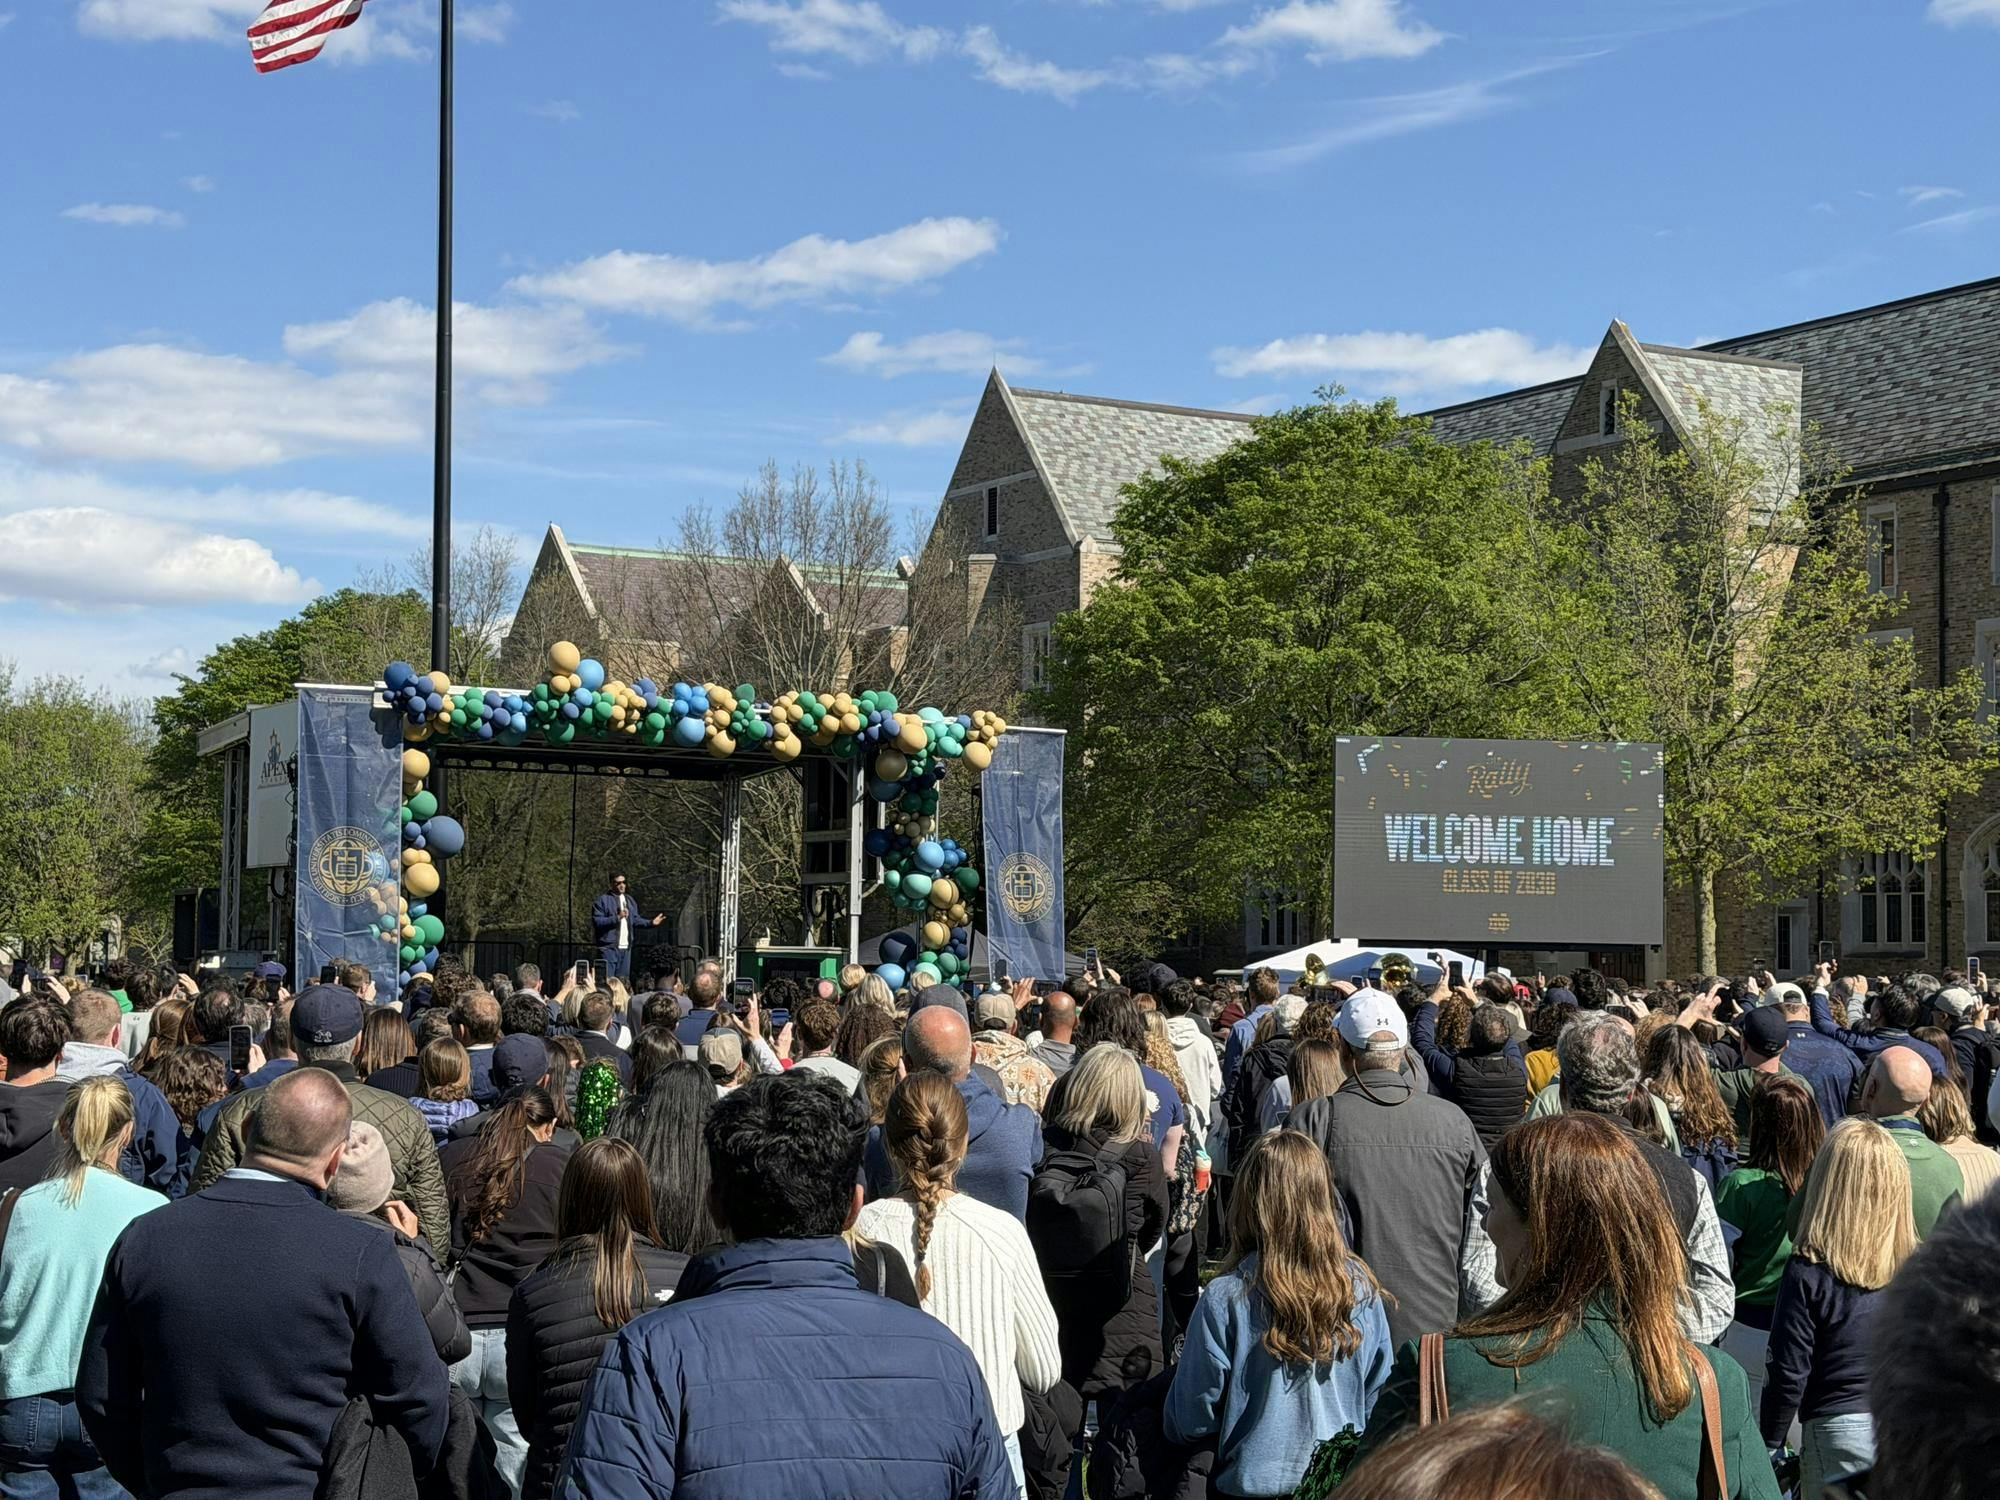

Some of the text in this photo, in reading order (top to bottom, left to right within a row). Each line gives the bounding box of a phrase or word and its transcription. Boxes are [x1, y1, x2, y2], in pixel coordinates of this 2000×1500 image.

[261, 760, 290, 778] APEX
[1467, 757, 1532, 799] Rally
[310, 828, 343, 876] UNIVERSITATIS
[1384, 813, 1615, 866] WELCOME HOME
[1443, 869, 1490, 893] CLASS
[1493, 870, 1512, 894] OF
